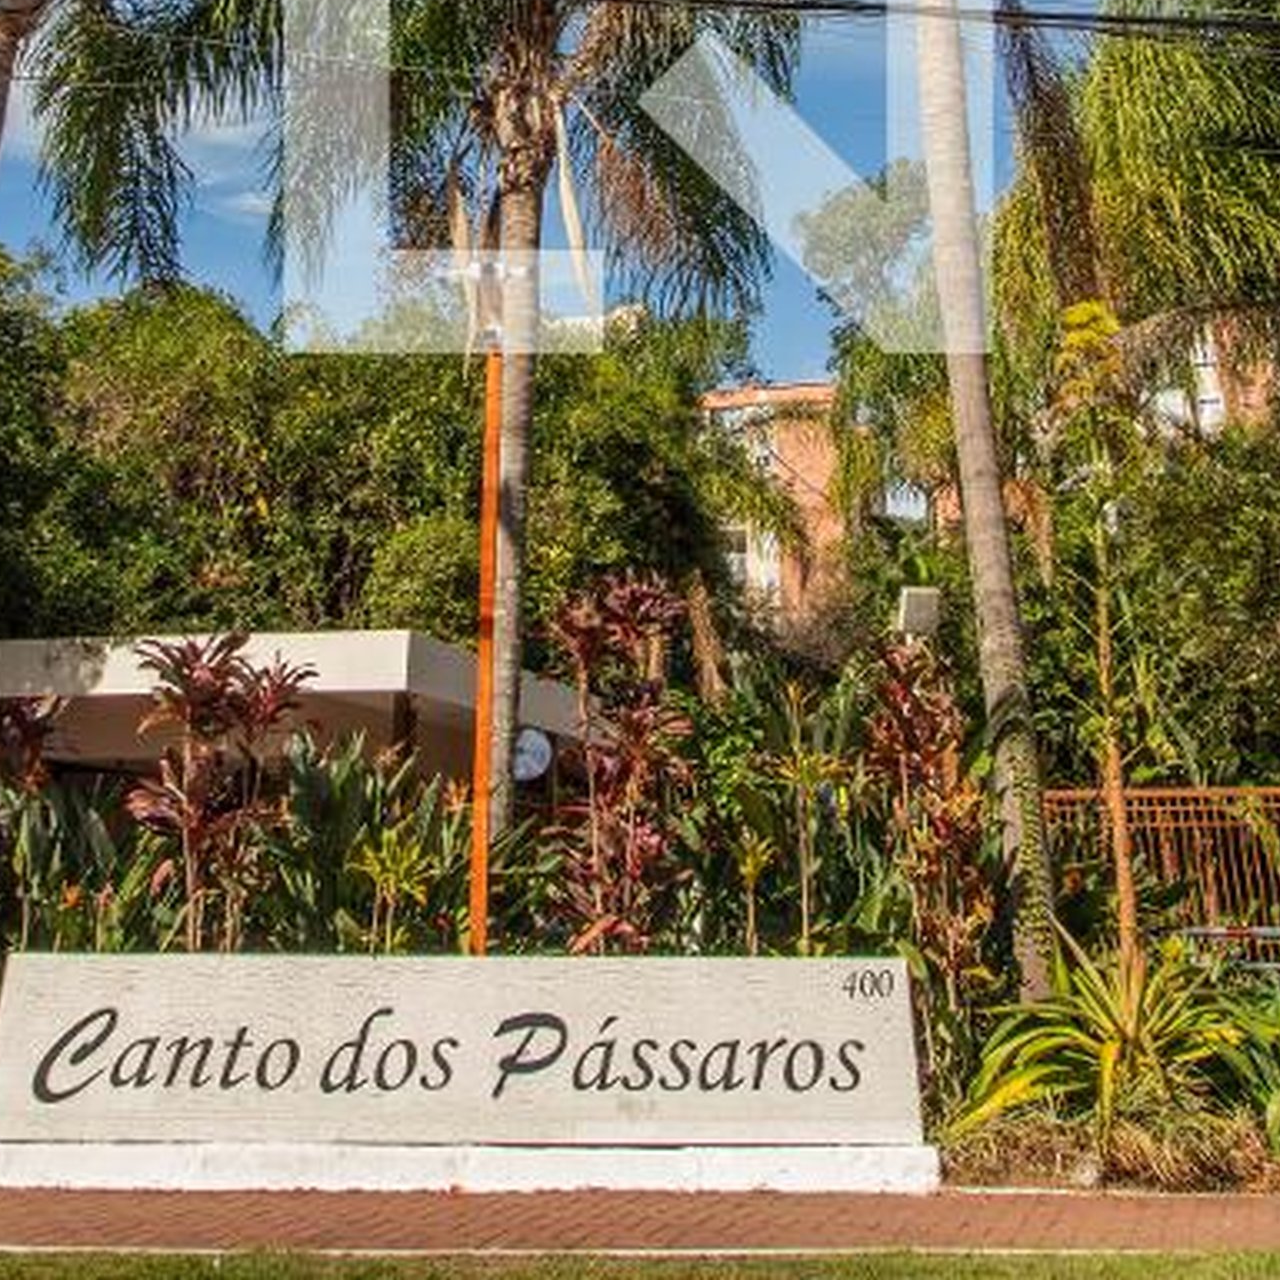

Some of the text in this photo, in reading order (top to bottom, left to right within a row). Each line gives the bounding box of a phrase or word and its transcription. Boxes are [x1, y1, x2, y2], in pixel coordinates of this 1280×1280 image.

[841, 969, 895, 1000] 400
[32, 1007, 866, 1104] Canto dos Pássaros
